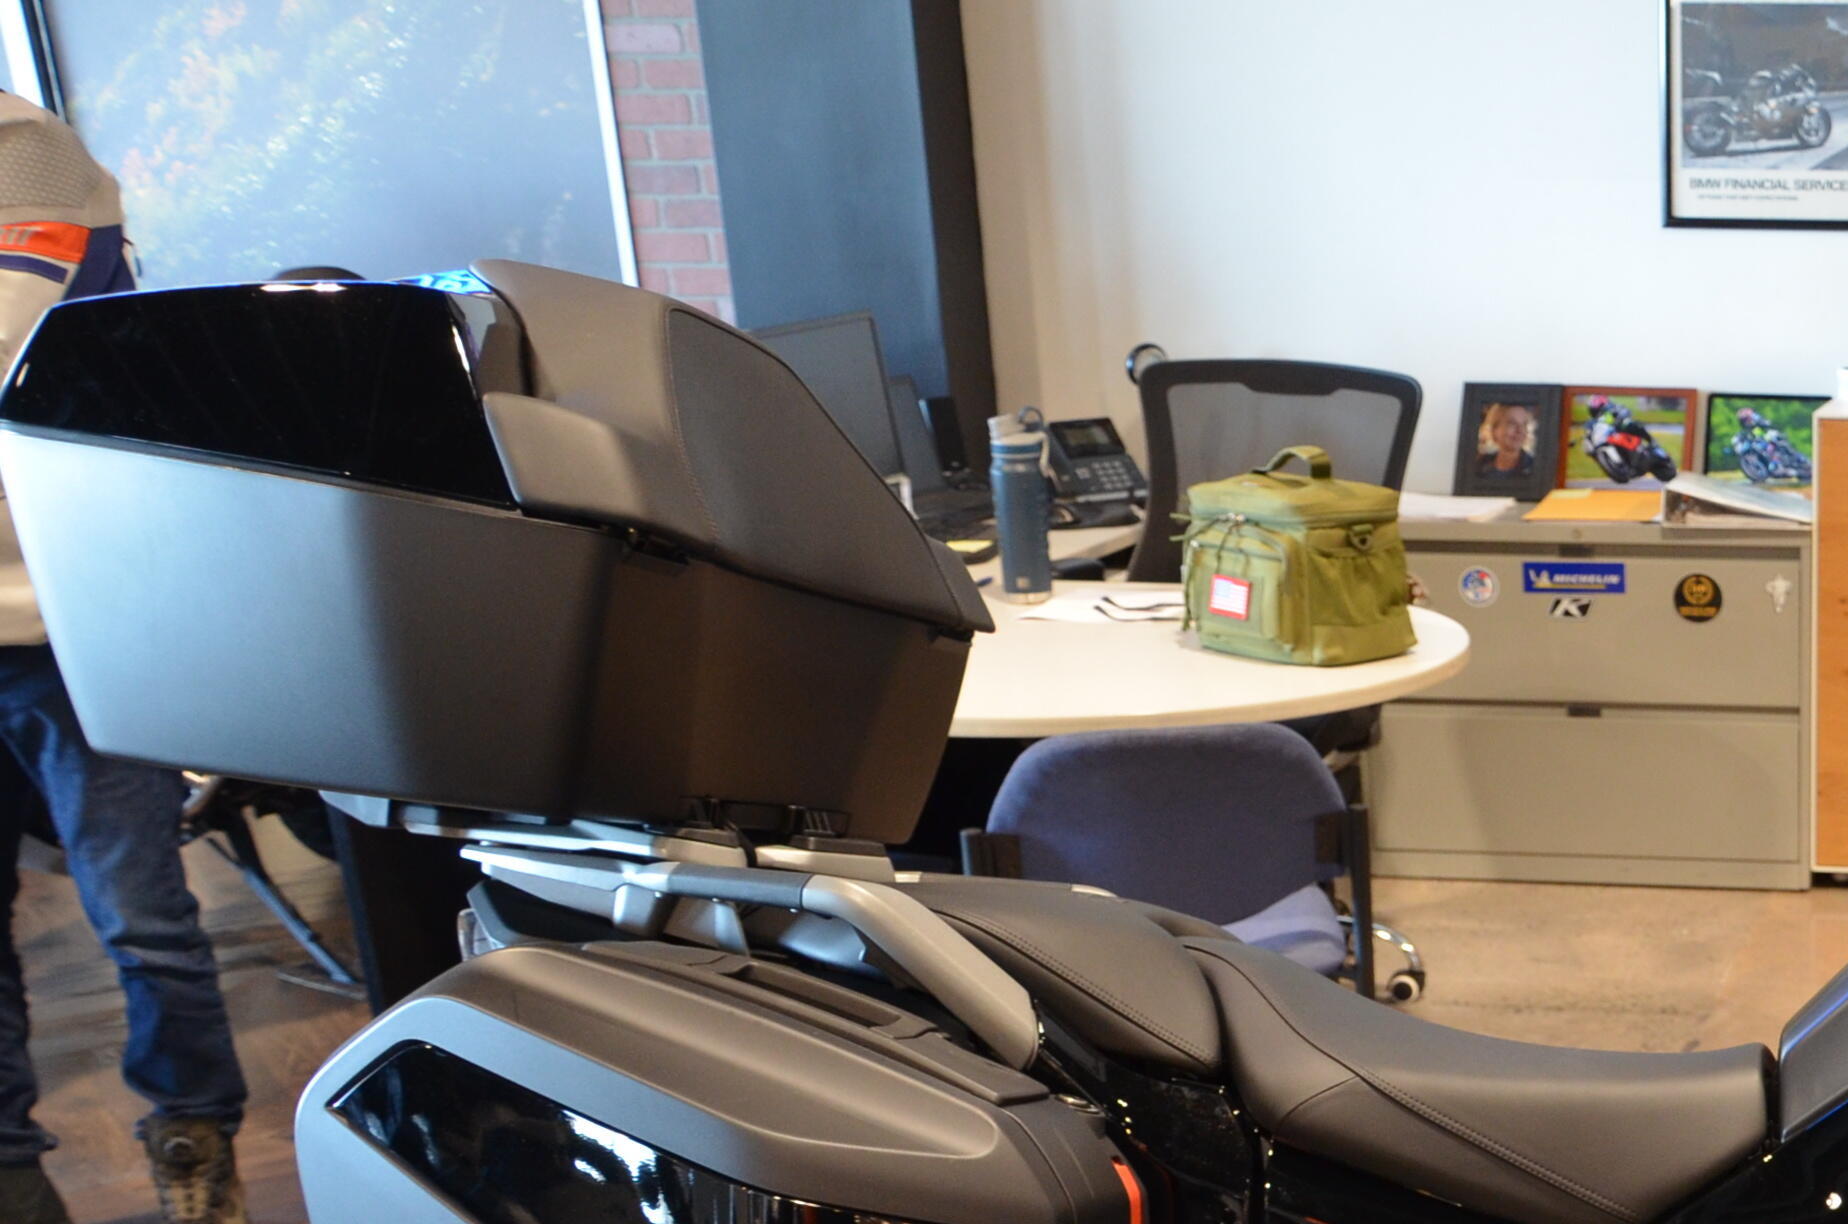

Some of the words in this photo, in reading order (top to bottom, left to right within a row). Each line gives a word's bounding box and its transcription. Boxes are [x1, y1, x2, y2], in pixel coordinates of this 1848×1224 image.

[1689, 178, 1721, 190] BMW
[1724, 178, 1790, 191] FINANCIAL
[1552, 573, 1620, 585] MICHELIN
